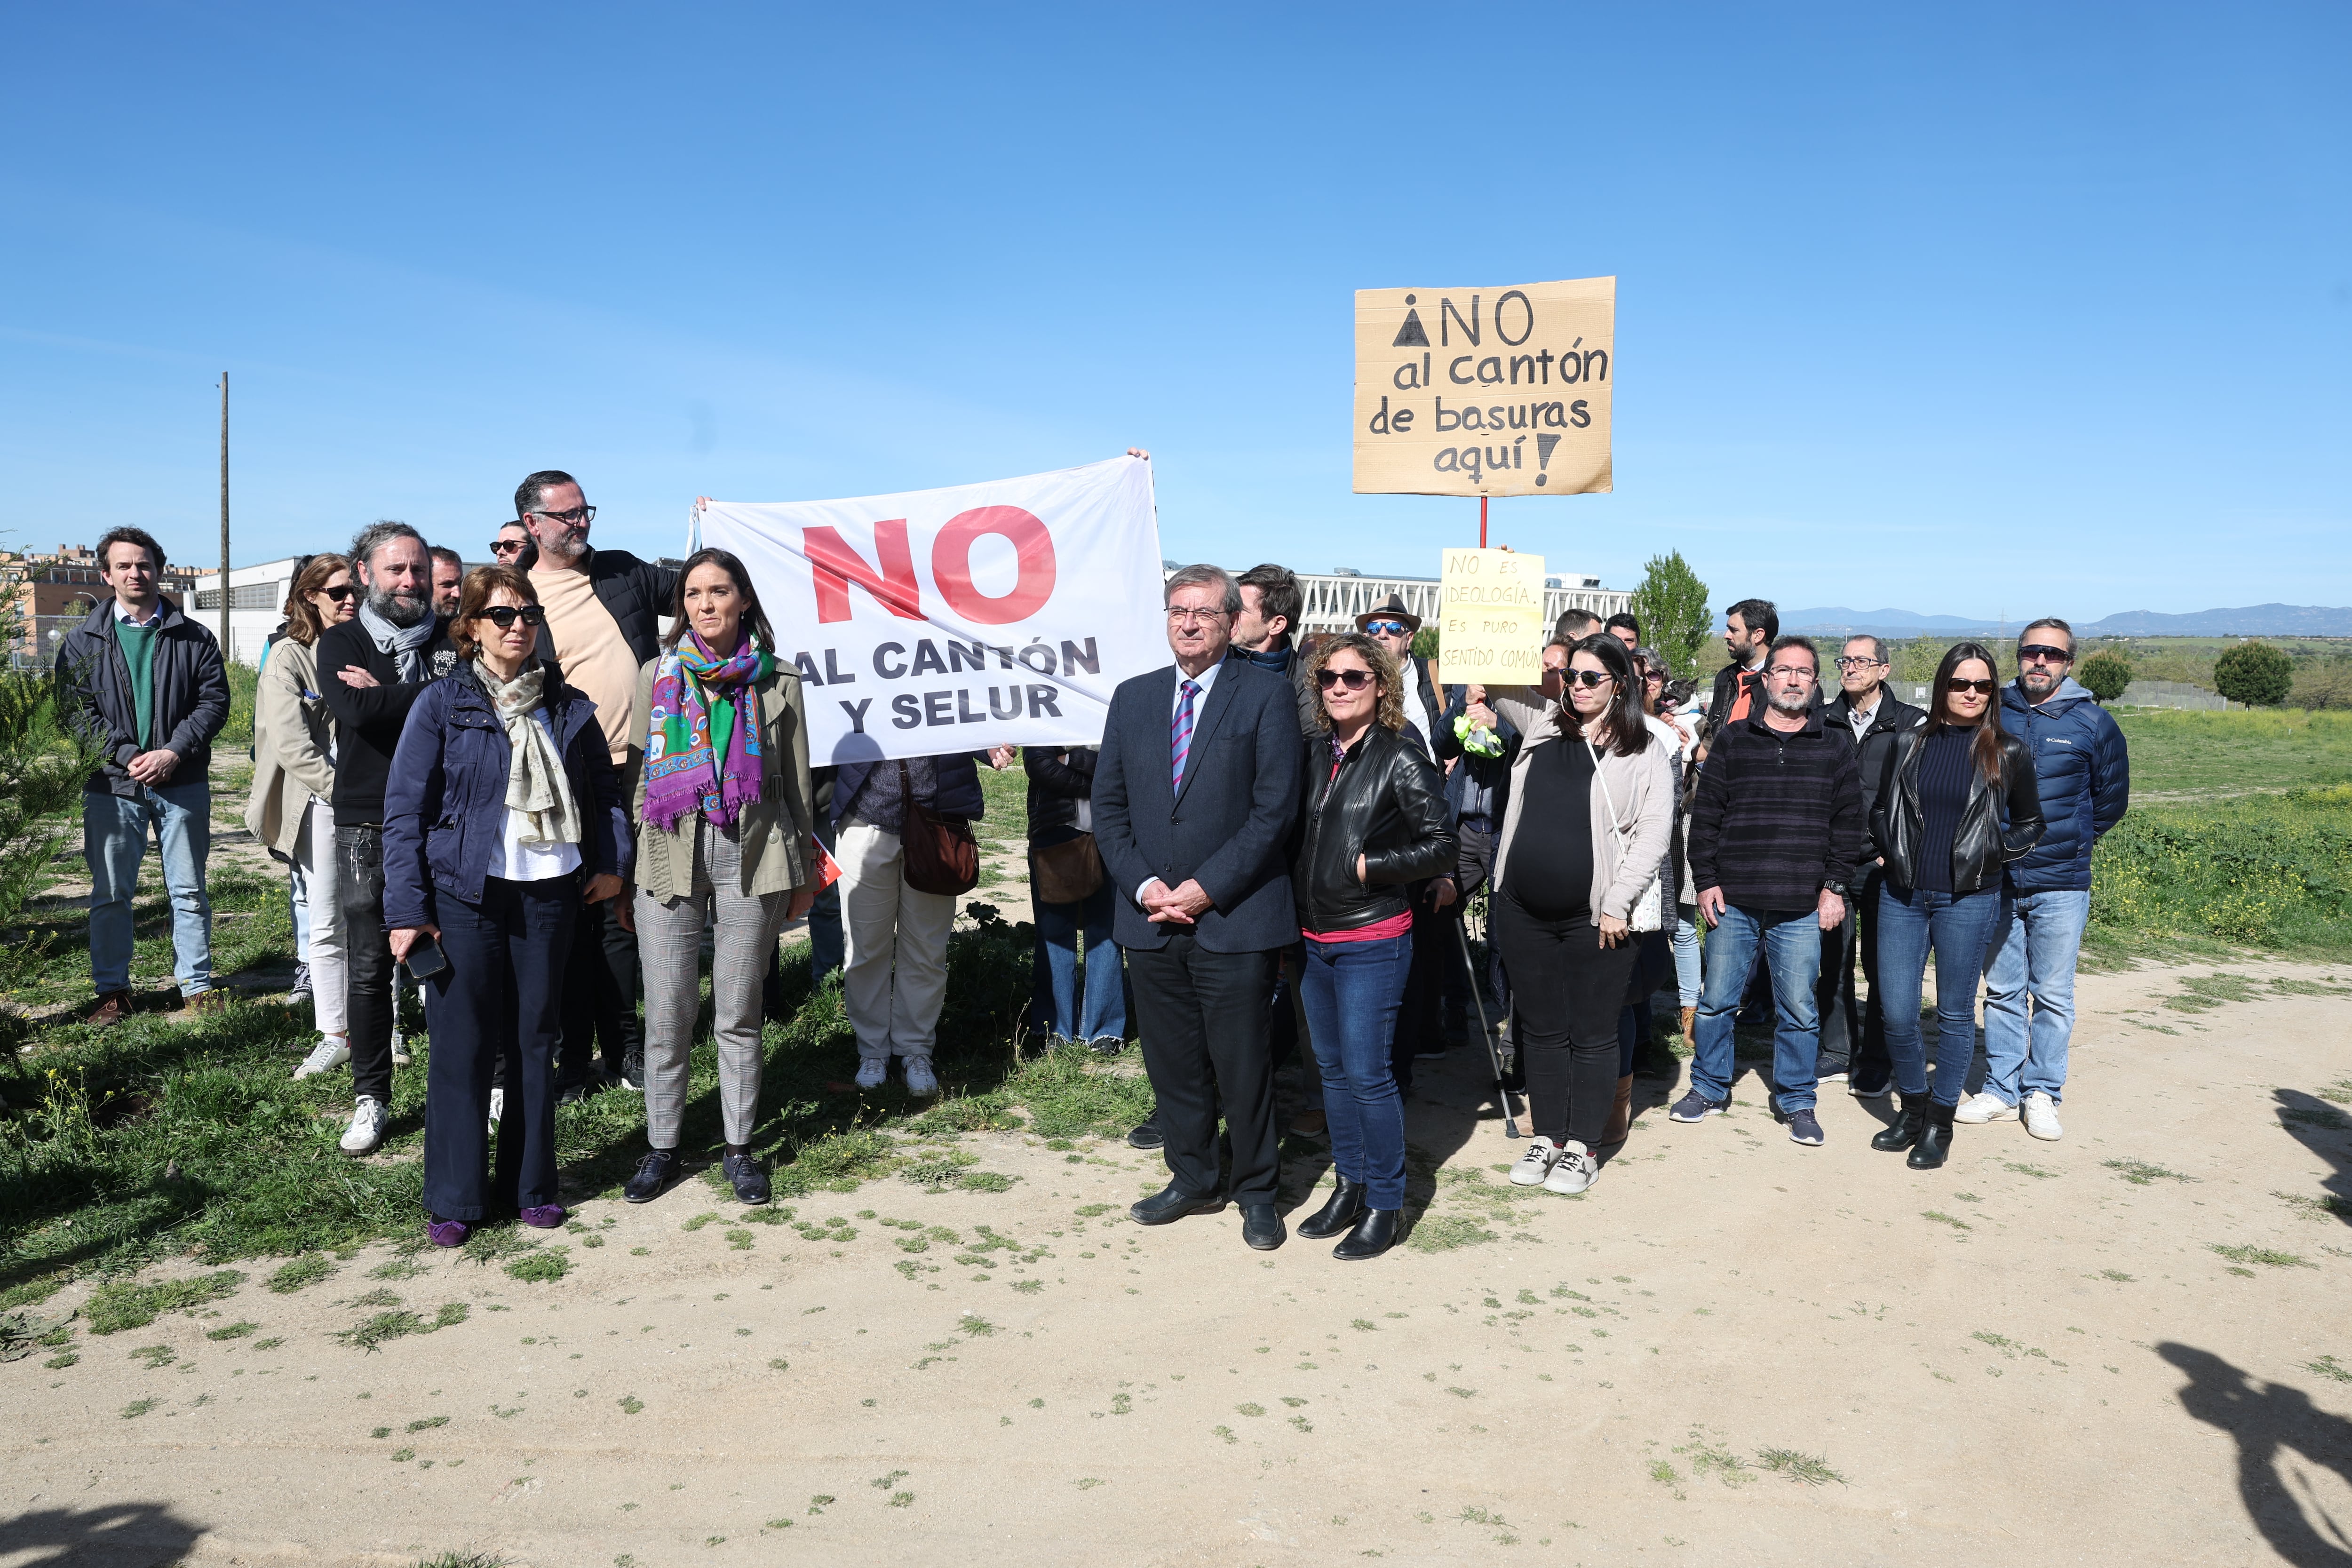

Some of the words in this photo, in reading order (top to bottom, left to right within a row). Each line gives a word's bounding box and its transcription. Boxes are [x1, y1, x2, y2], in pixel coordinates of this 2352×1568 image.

[1393, 352, 1430, 390] al
[1449, 336, 1608, 384] cantón
[1369, 396, 1414, 435] de
[1435, 396, 1591, 432] basuras
[802, 504, 1057, 625] NO
[1450, 555, 1479, 574] NO
[1500, 561, 1517, 574] ES
[1445, 581, 1536, 605] IDEOLOGÍA.
[1448, 620, 1466, 632] ES
[1483, 621, 1518, 633] PURO
[795, 648, 855, 686] AL
[873, 637, 1101, 680] CANTÓN
[1501, 645, 1542, 669] COMÚN
[838, 698, 873, 733] Y
[891, 684, 1063, 730] SELUR
